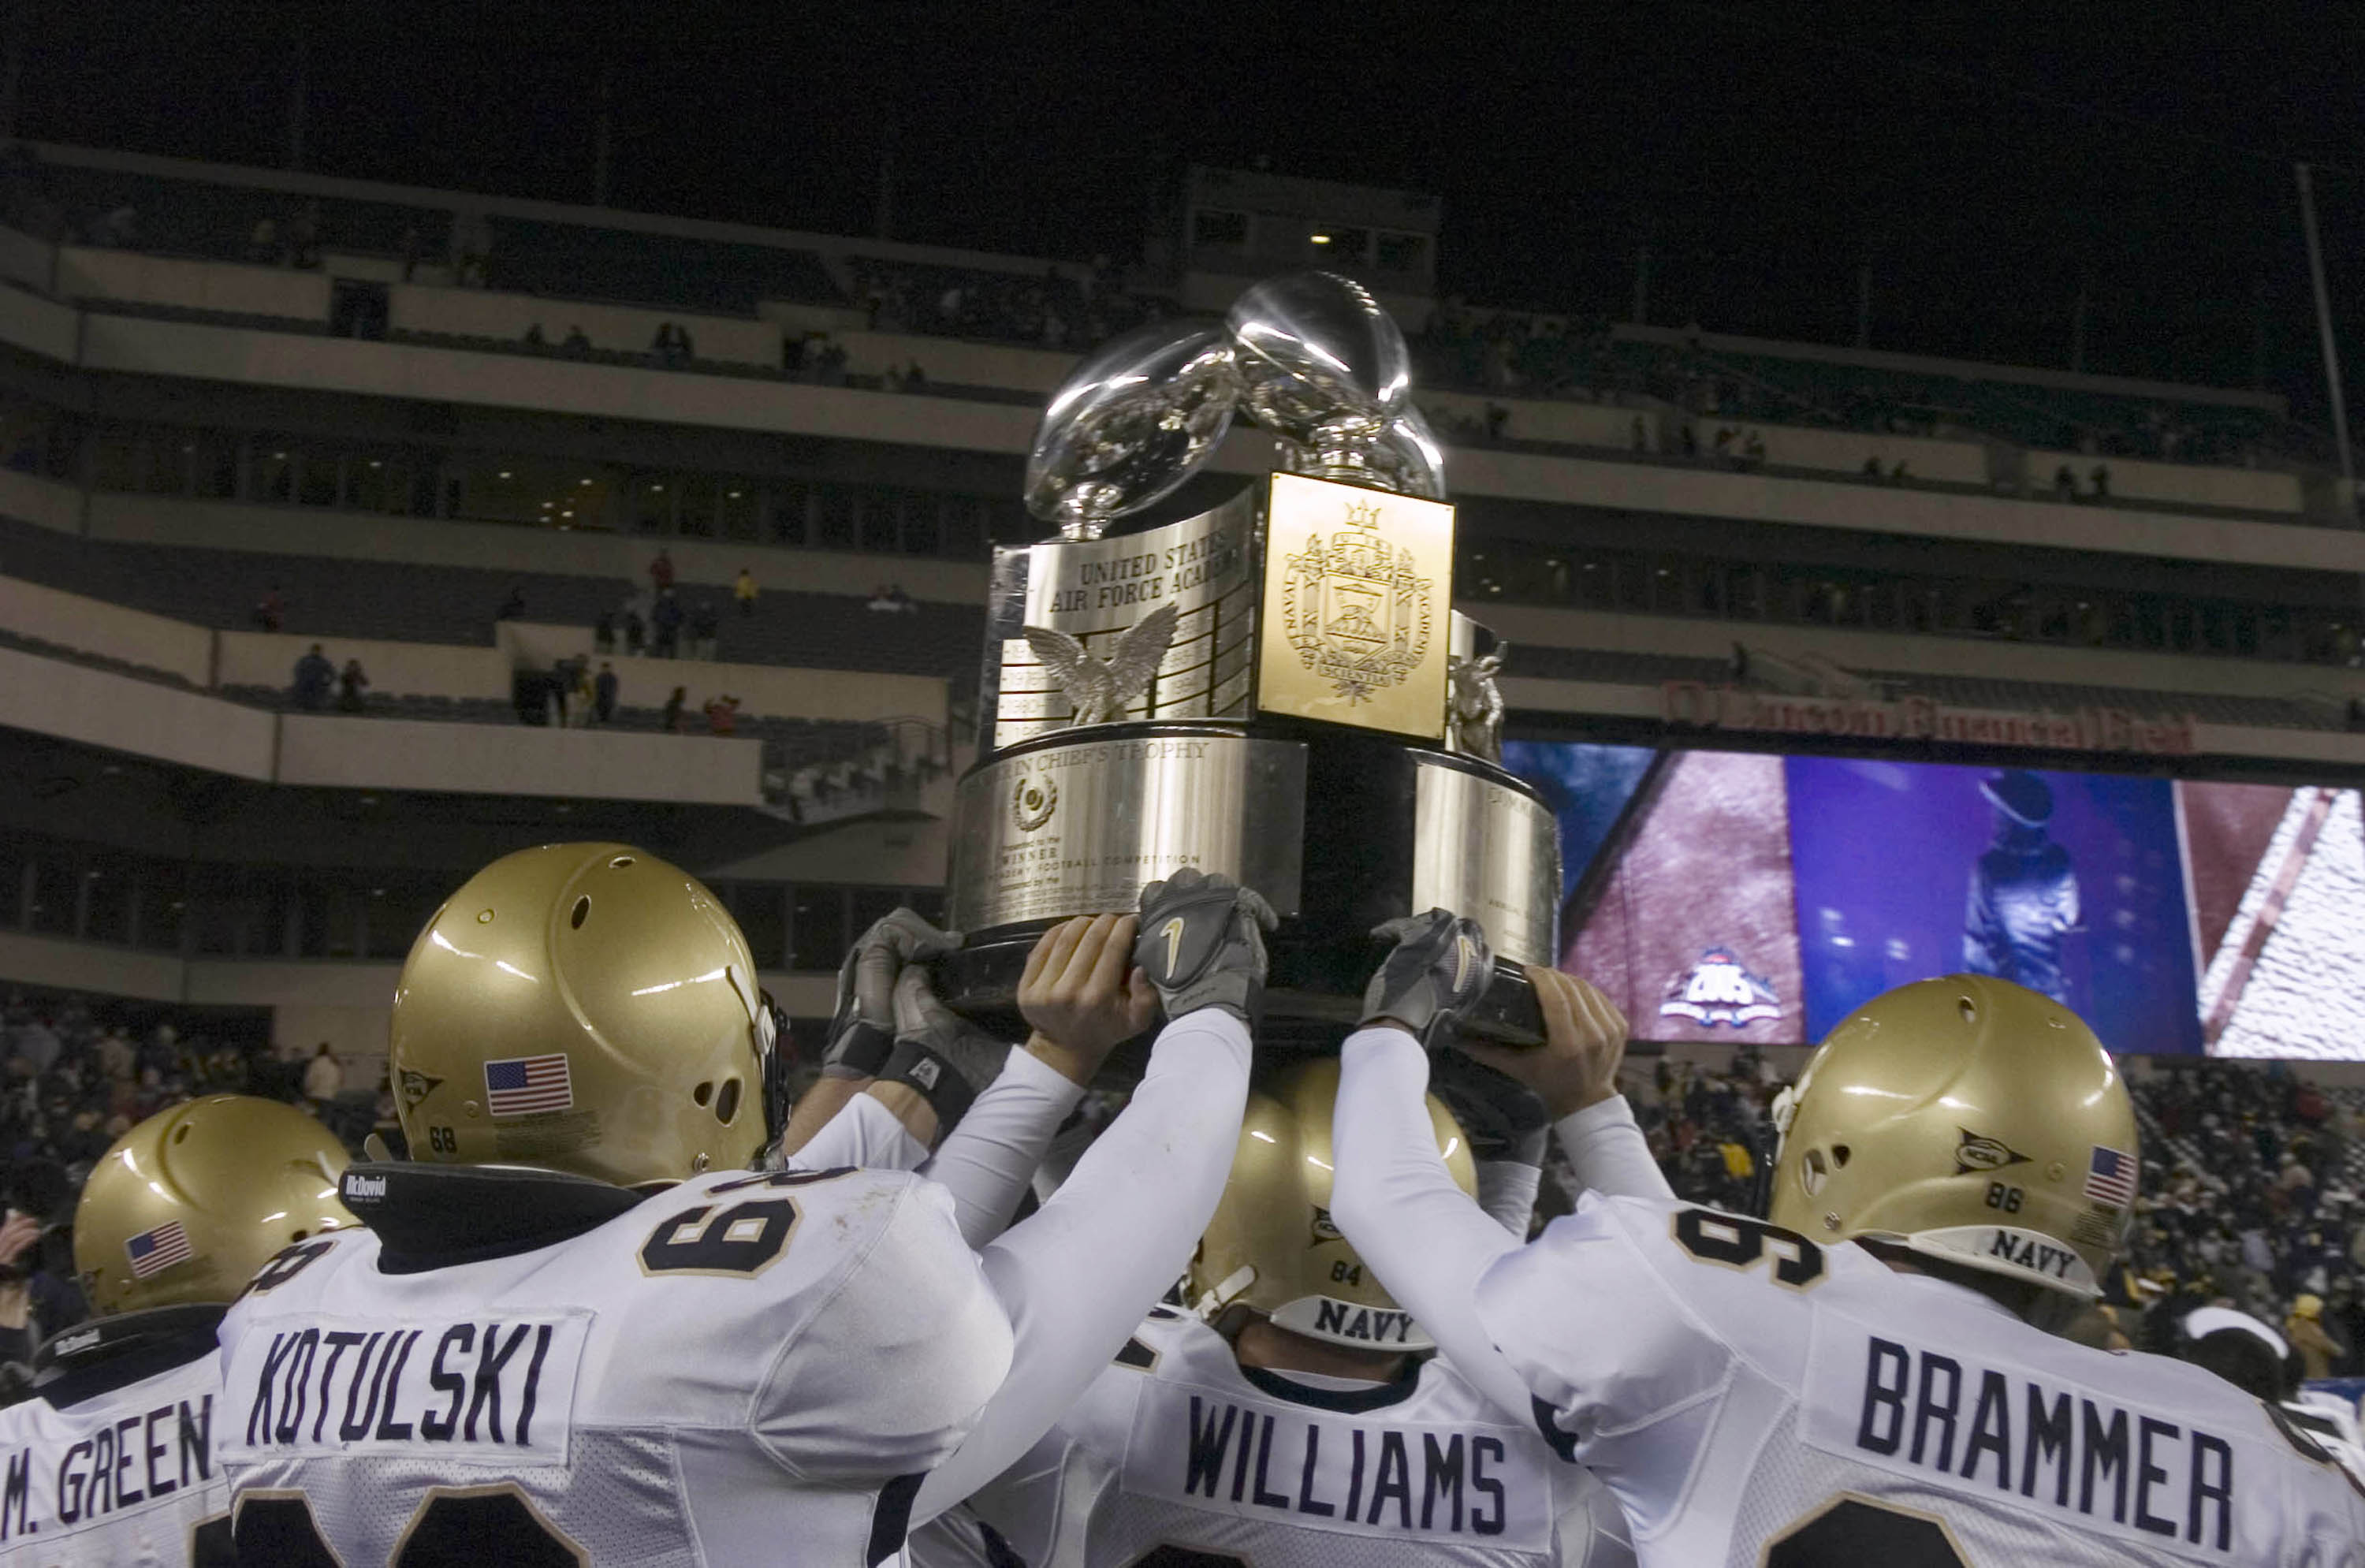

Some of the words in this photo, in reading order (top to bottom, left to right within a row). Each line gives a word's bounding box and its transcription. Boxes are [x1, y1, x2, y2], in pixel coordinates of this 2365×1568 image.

[1048, 587, 1089, 613] AIR
[1097, 576, 1163, 609] FORCE
[1079, 553, 1156, 586] UNITED
[429, 1126, 458, 1153] 68
[1990, 1229, 2076, 1279] NAVY
[1314, 1299, 1414, 1343] NAVY
[246, 1324, 553, 1446] KOTULSKI
[2, 1447, 39, 1540] M.
[58, 1394, 213, 1525] GREEN
[1185, 1395, 1505, 1535] WILLIAMS
[1857, 1335, 2233, 1551] BRAMMER
